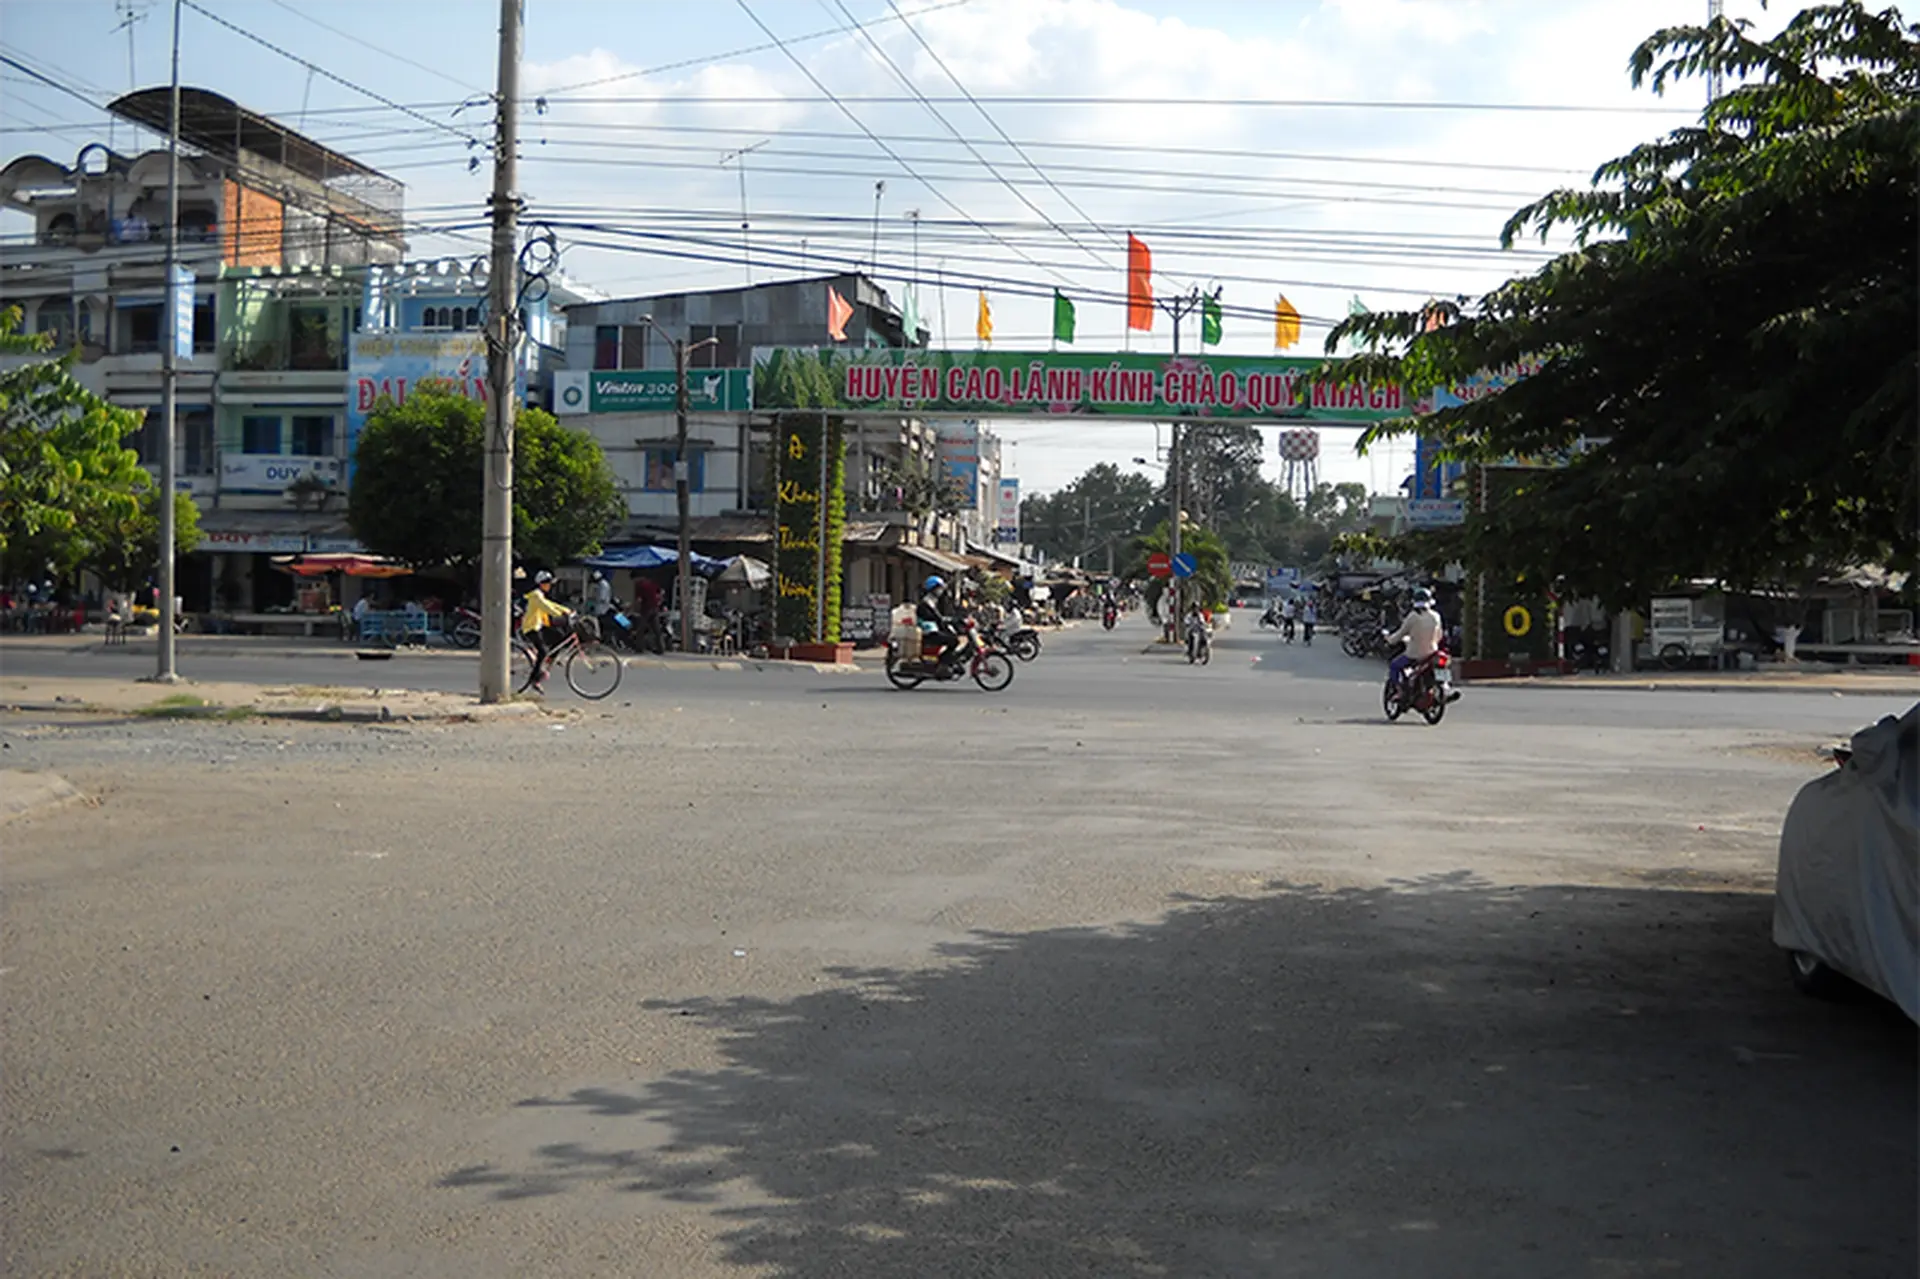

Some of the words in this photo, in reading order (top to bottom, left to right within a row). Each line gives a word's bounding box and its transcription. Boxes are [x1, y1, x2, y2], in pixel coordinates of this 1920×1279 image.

[848, 361, 939, 406] HUYỆN
[949, 367, 1001, 400] CAO
[1012, 361, 1081, 401] LÃNH
[1091, 362, 1154, 403] KÍNH
[1165, 364, 1237, 405] CHÀO
[266, 466, 301, 480] DUY
